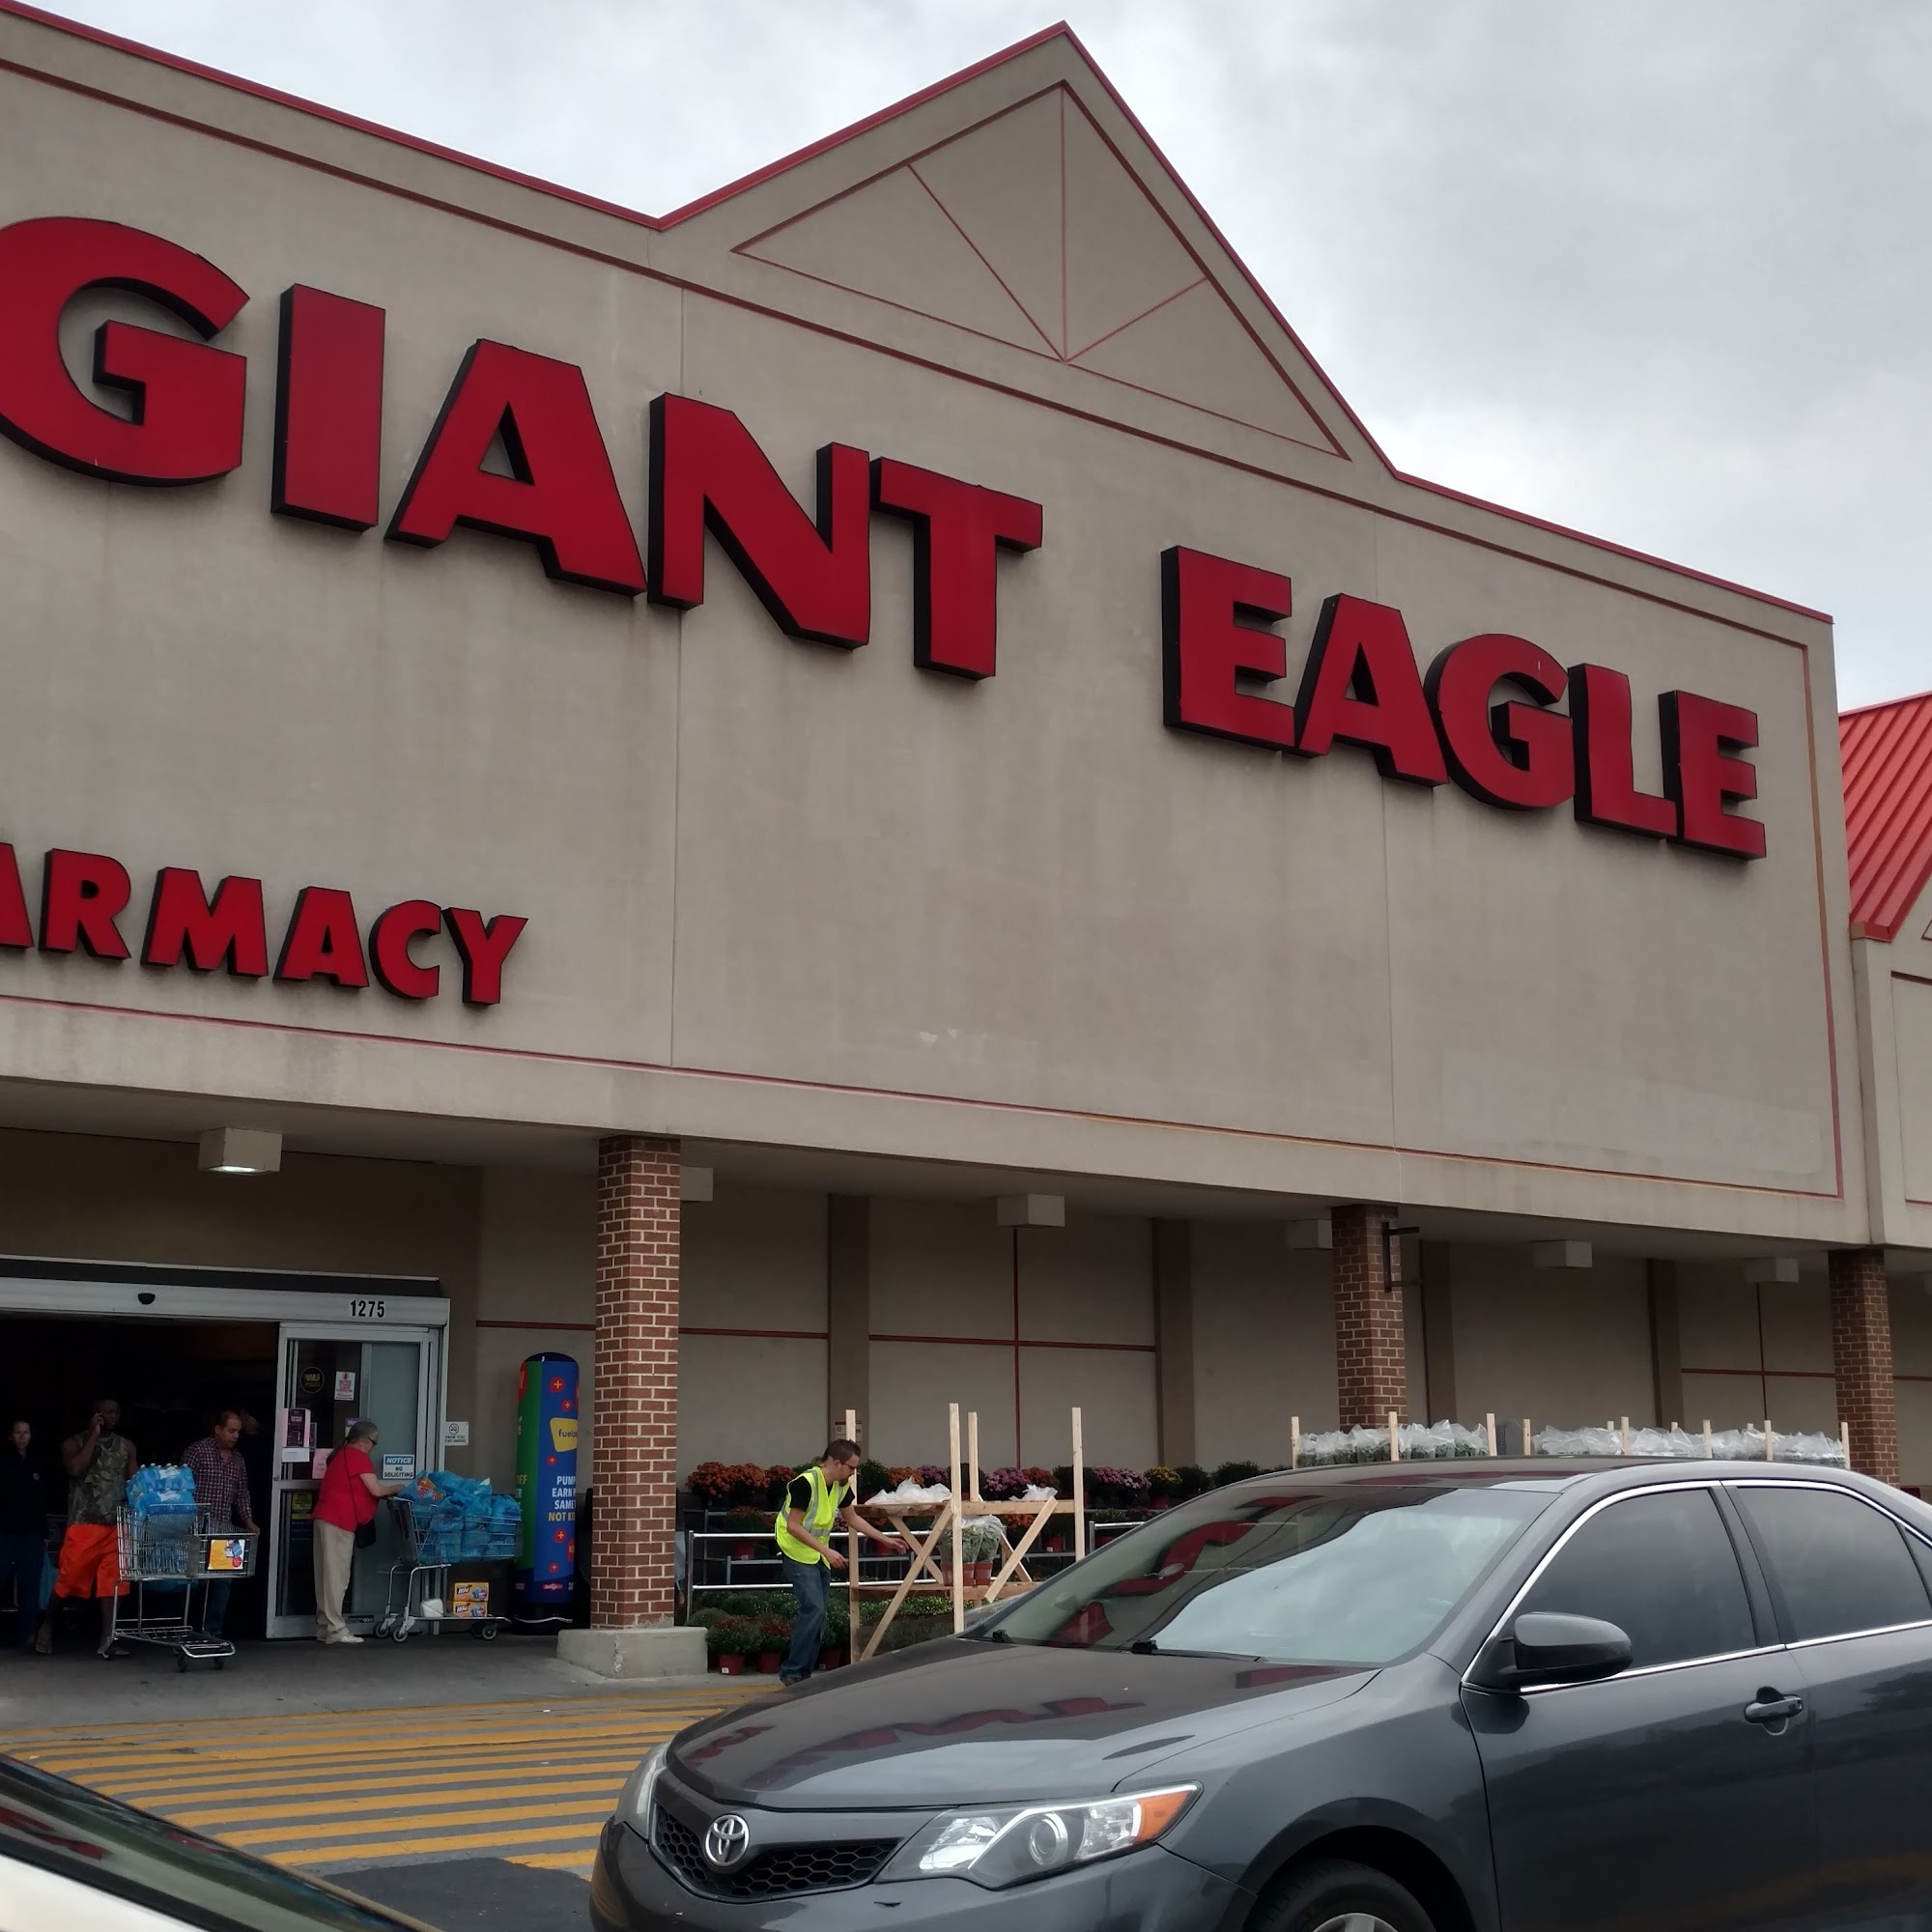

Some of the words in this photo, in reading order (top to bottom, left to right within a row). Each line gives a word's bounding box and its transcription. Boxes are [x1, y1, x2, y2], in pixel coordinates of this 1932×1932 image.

[0, 216, 1042, 678] GIANT
[1161, 545, 1767, 860] EAGLE
[351, 1299, 384, 1318] 1275
[552, 1488, 573, 1497] EARN
[548, 1512, 566, 1521] NOT
